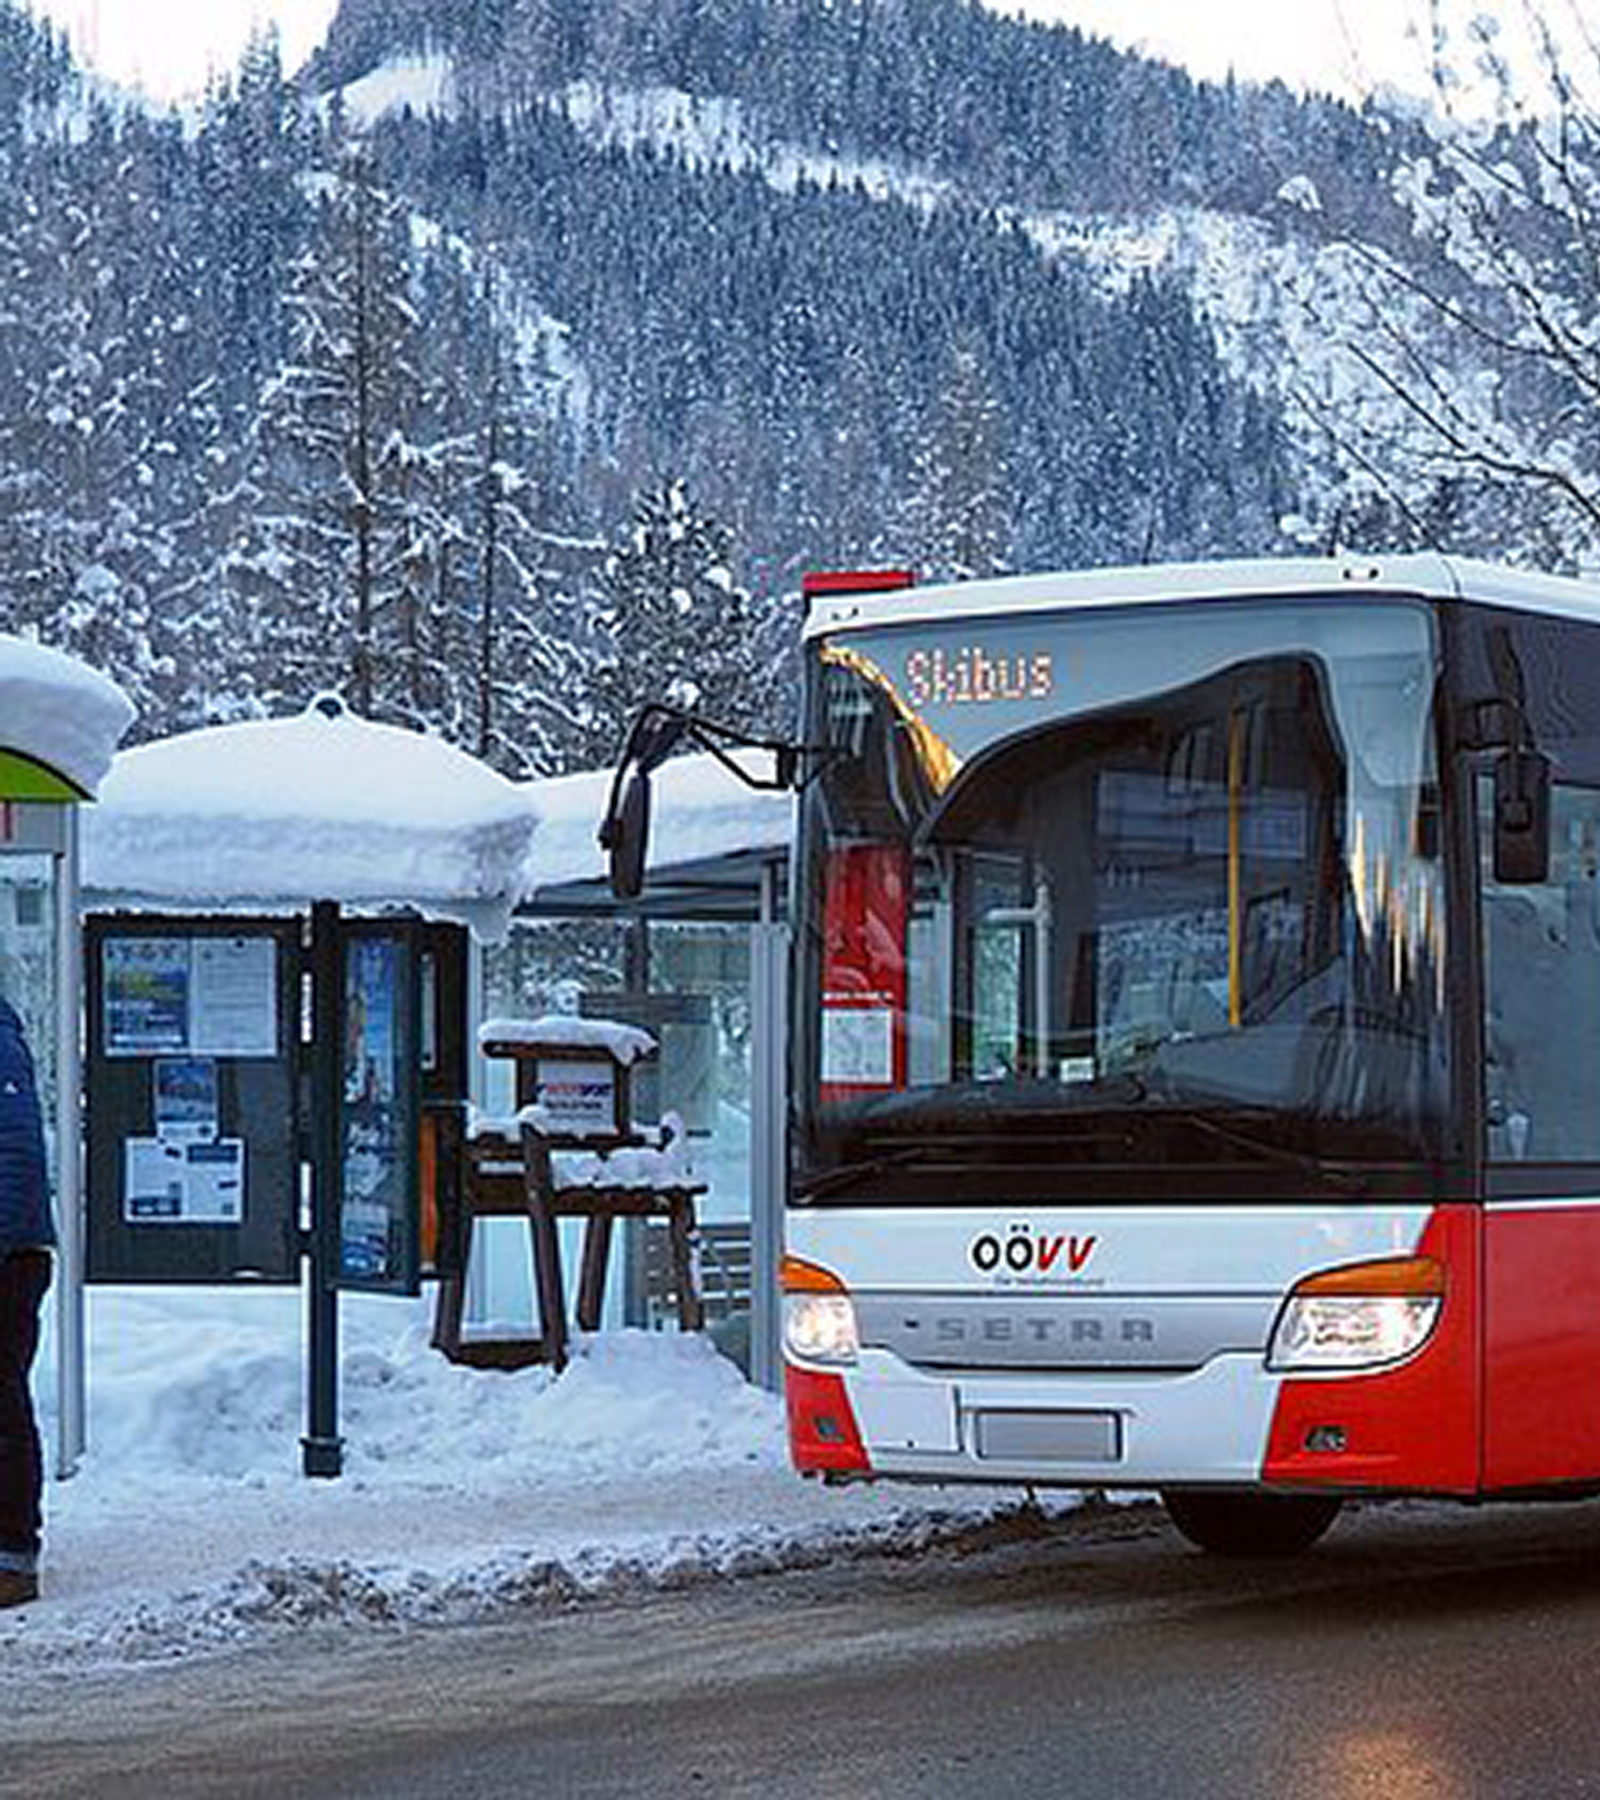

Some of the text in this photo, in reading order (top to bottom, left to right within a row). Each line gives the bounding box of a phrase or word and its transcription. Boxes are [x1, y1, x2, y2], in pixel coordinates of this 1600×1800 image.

[906, 648, 1052, 704] Skibus
[972, 1223, 1097, 1271] OÖVV
[937, 1318, 1154, 1342] SETRA
